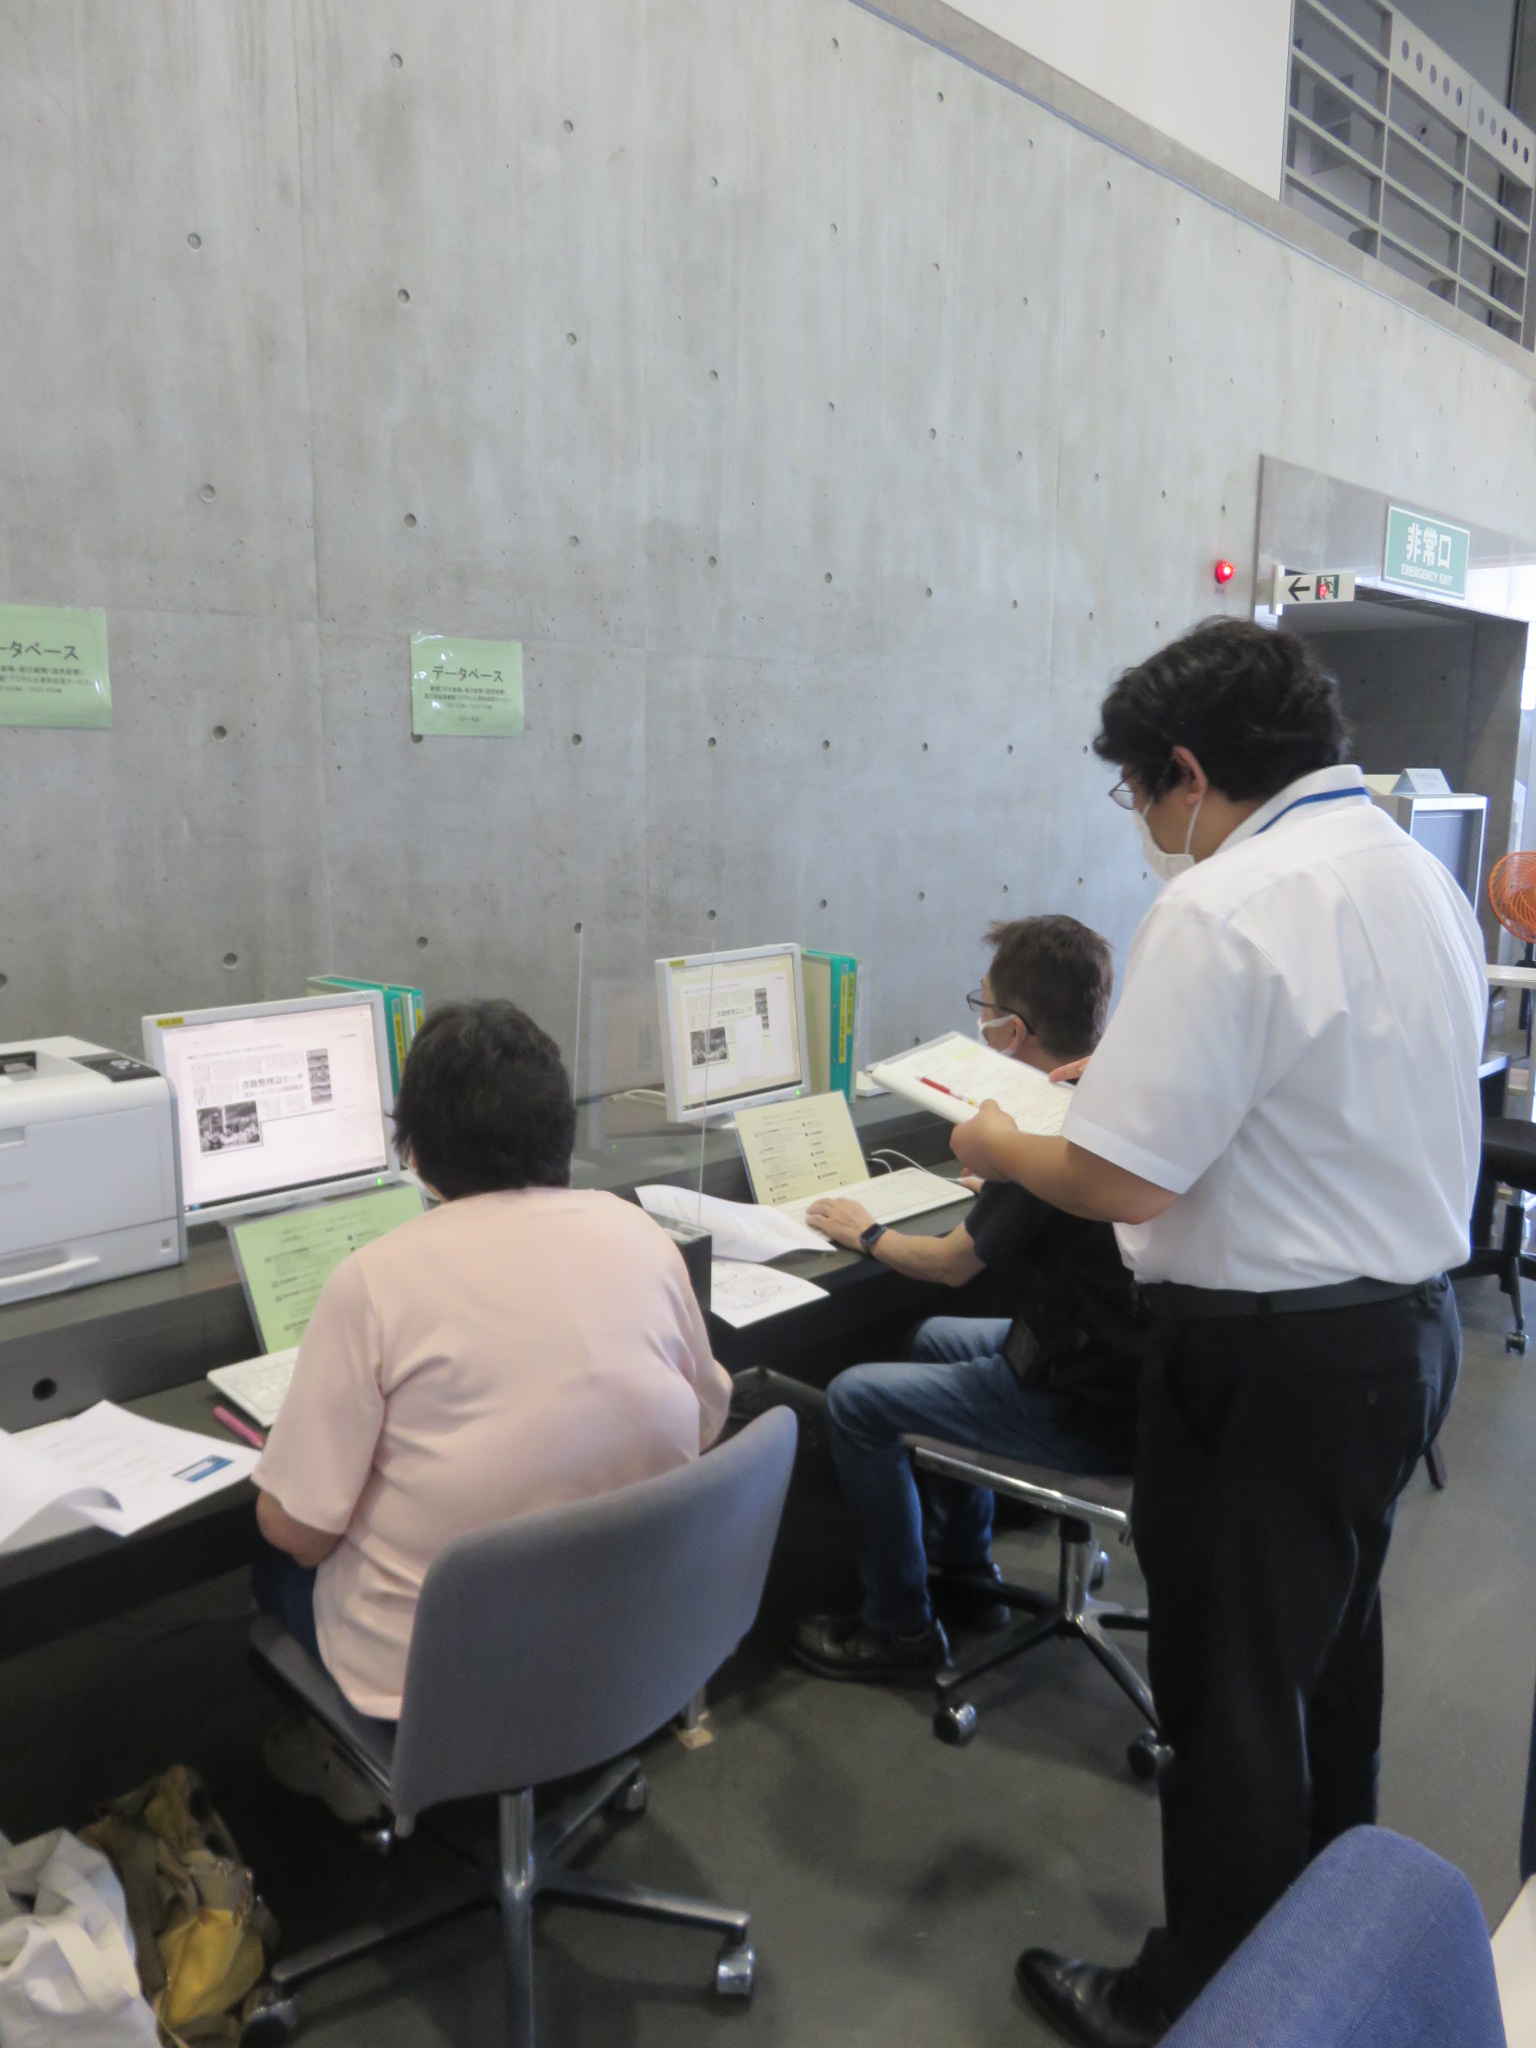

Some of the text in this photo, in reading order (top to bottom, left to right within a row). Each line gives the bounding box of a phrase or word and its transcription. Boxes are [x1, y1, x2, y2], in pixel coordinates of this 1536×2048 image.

[1406, 522, 1452, 569] 非常口
[1401, 564, 1453, 586] EMERGENCY EXIT
[432, 665, 504, 683] データベース
